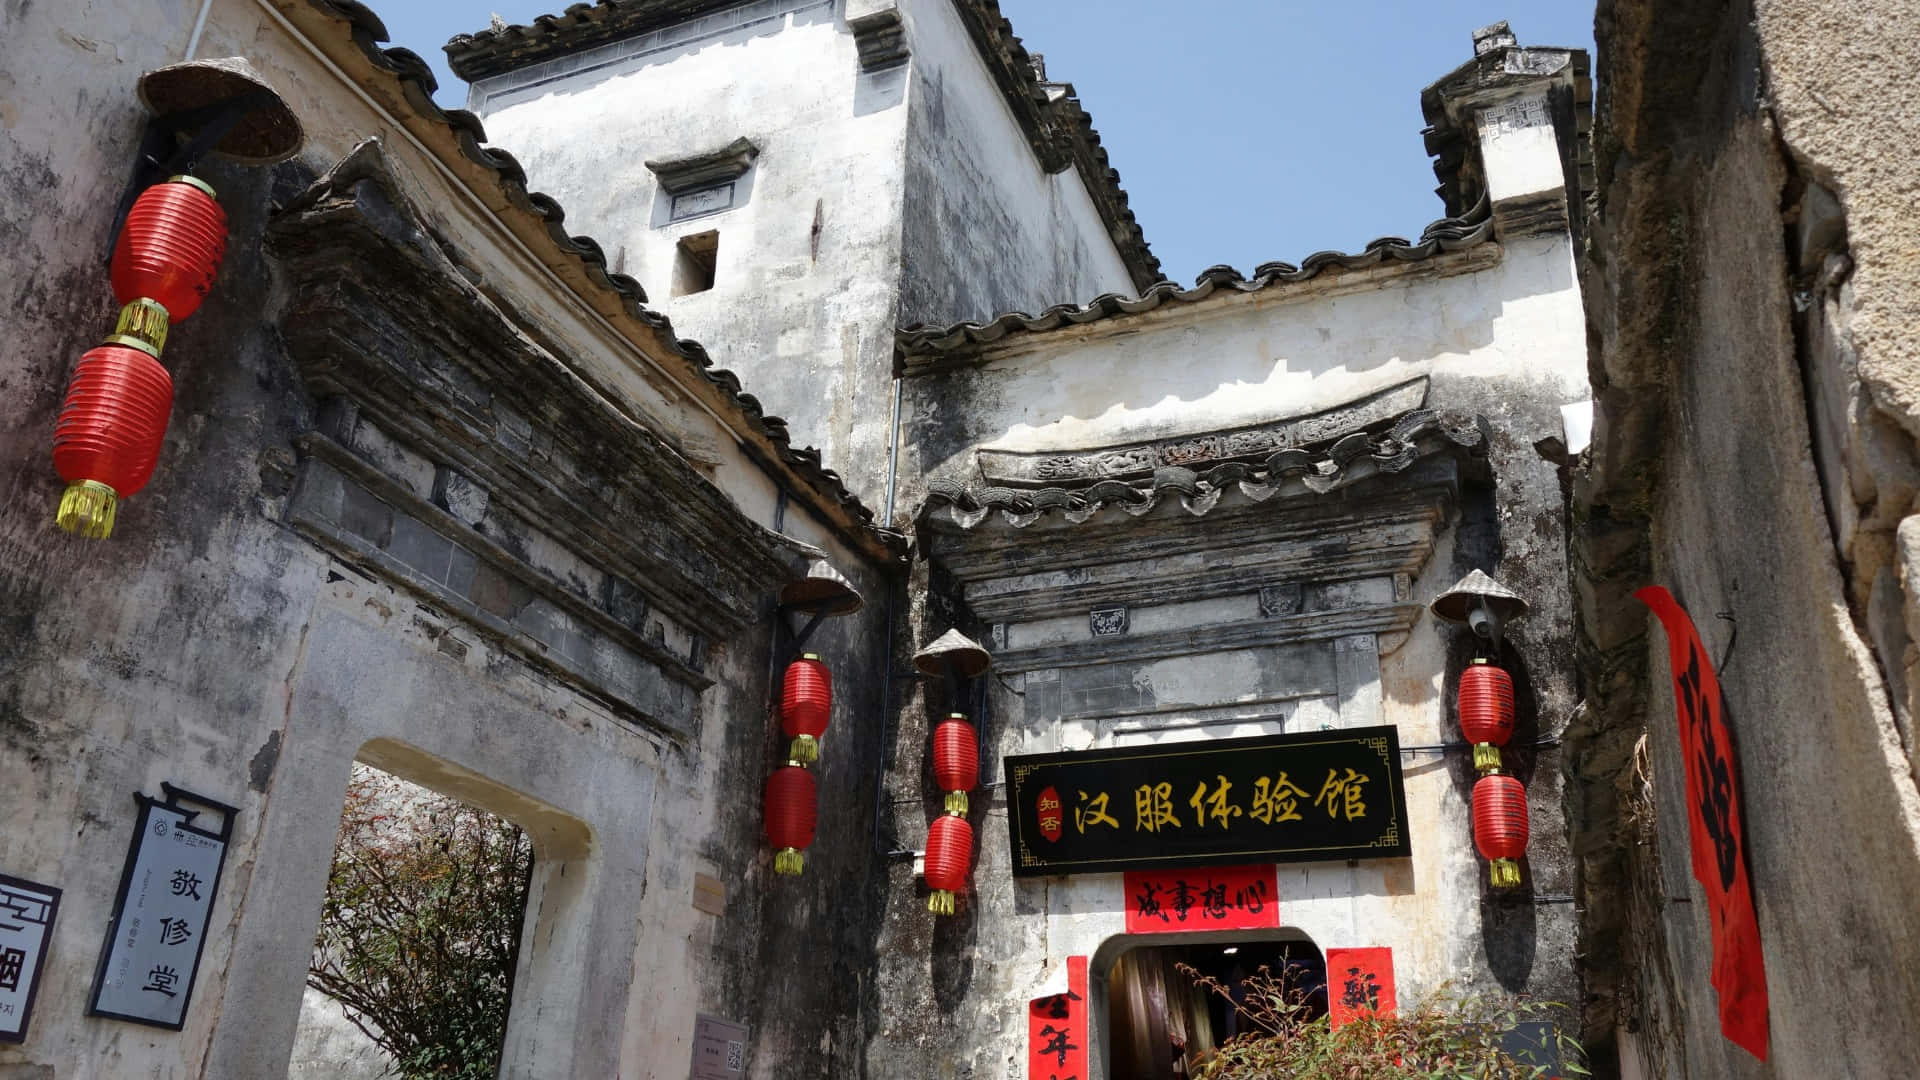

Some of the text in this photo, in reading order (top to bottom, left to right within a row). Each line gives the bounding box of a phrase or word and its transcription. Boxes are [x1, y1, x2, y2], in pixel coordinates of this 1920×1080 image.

[1040, 797, 1060, 831] 知否
[1074, 769, 1370, 834] 汉服体验馆
[142, 869, 202, 998] 敬修堂
